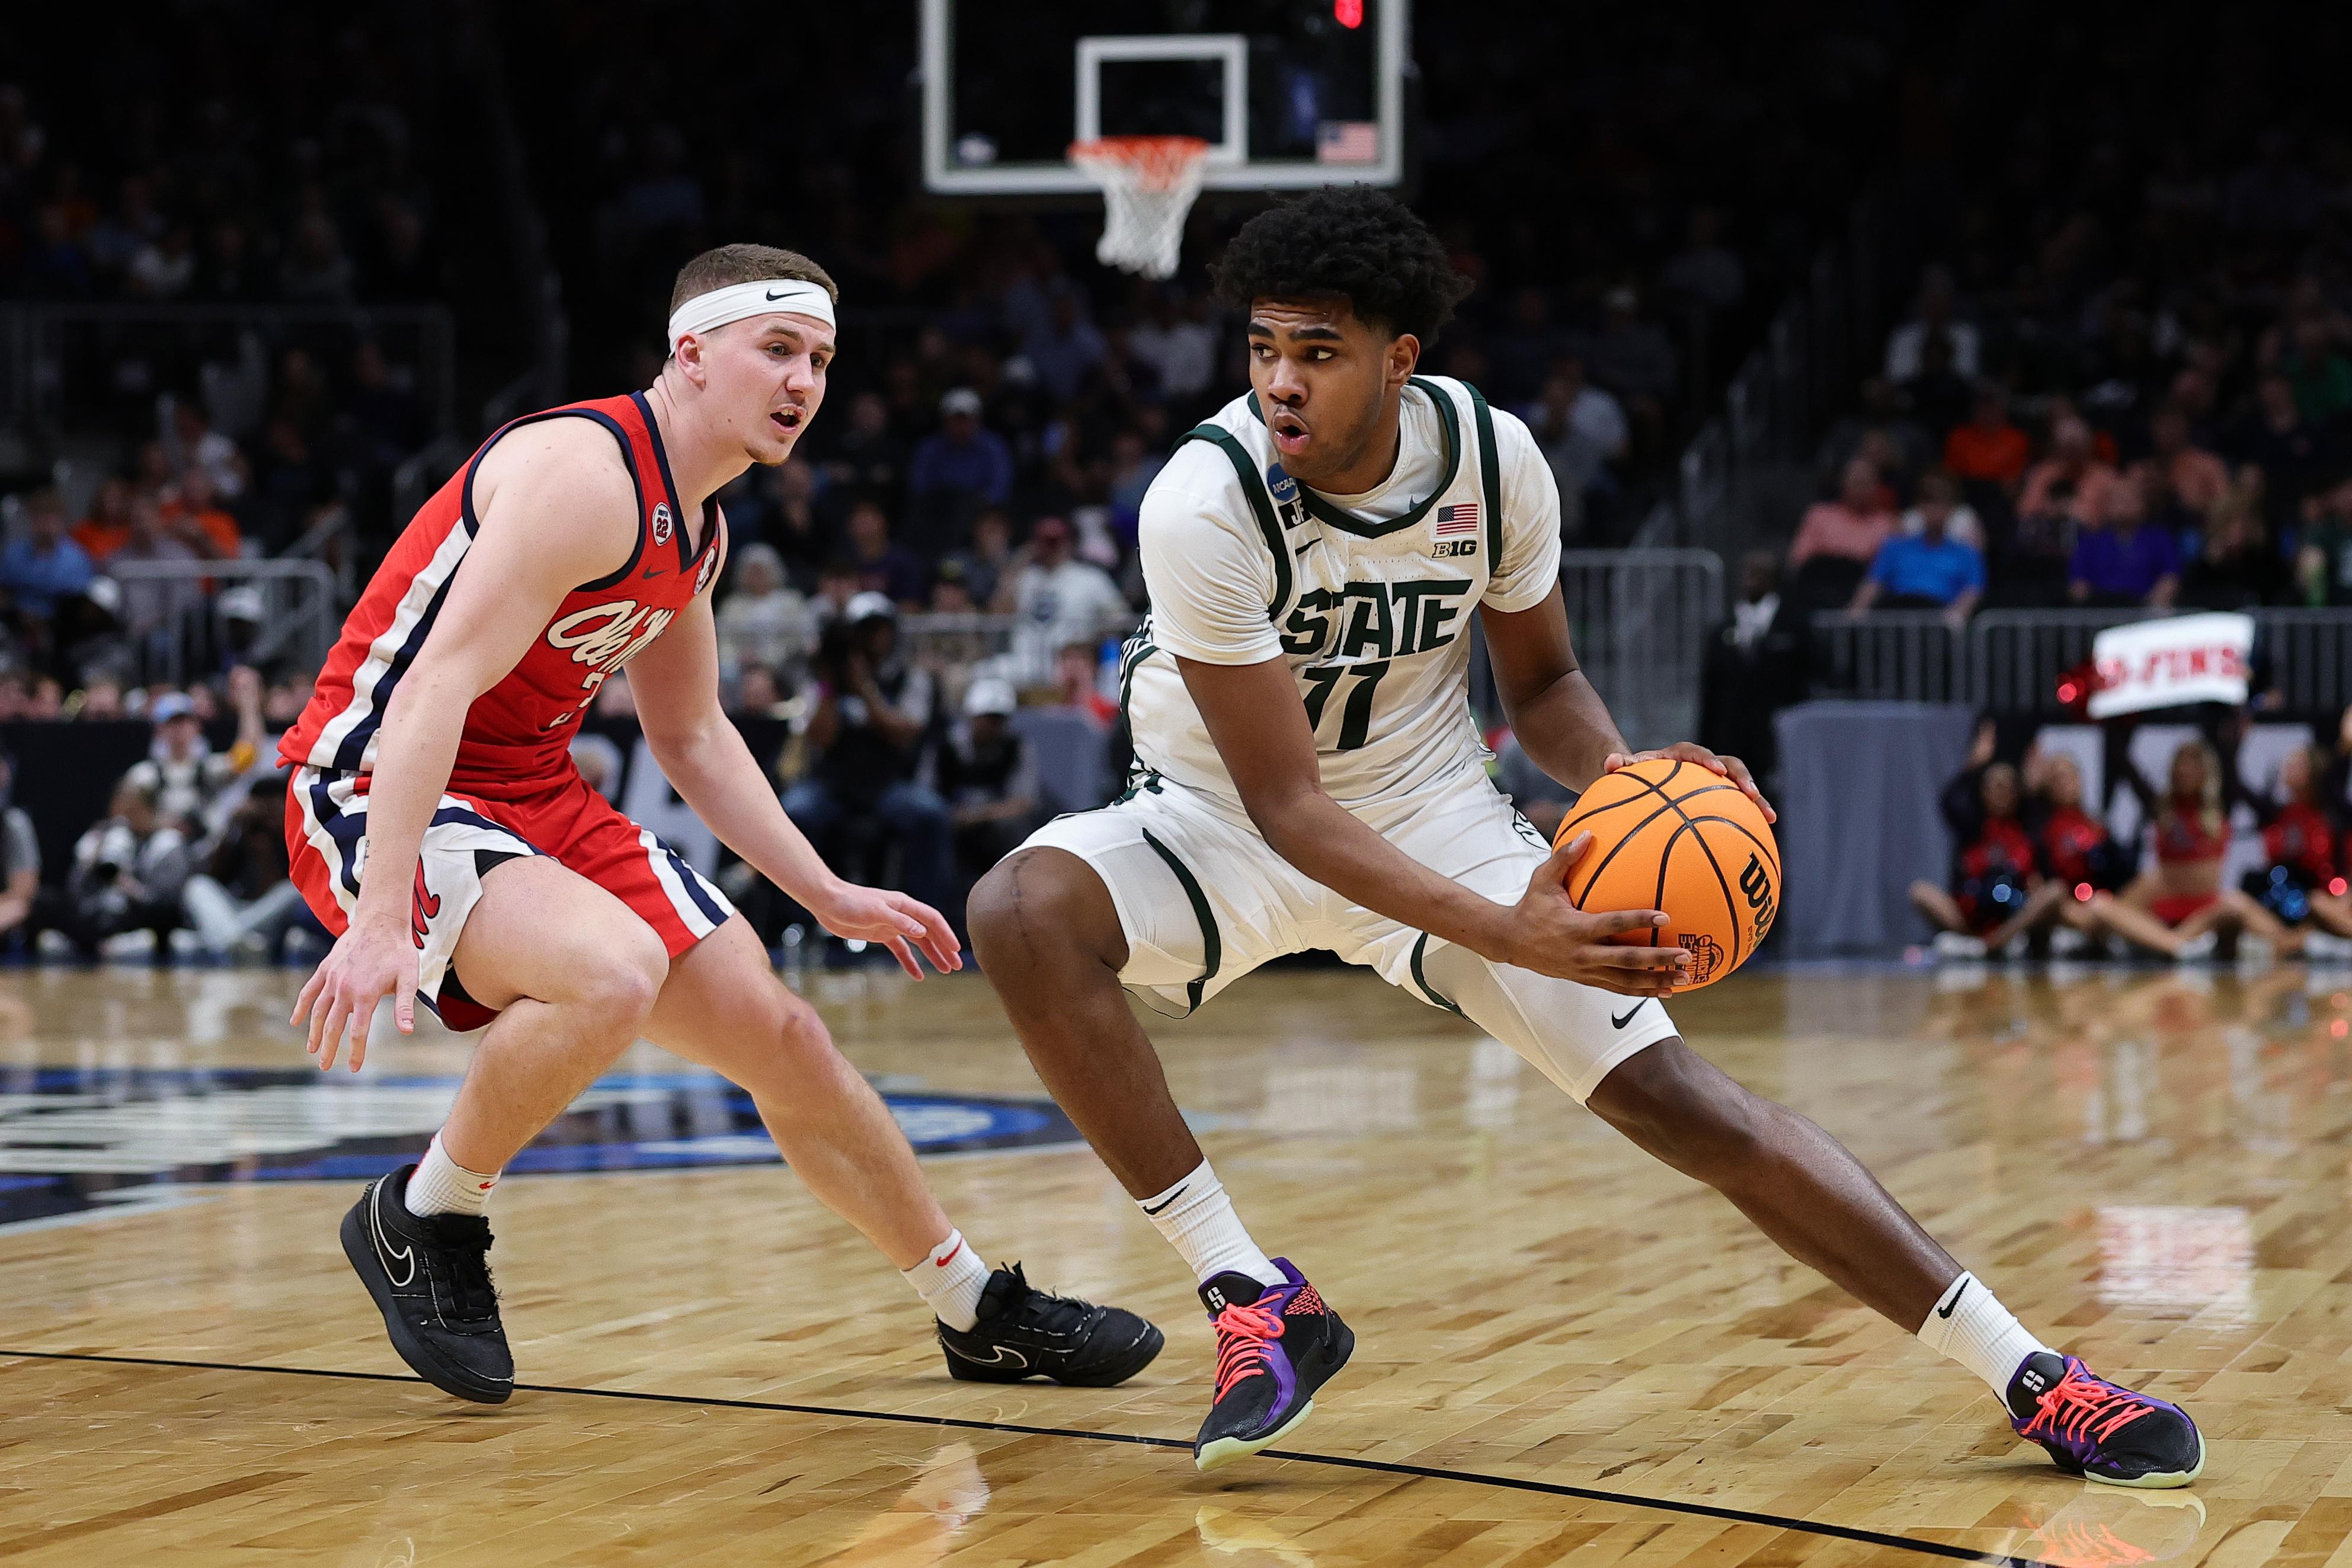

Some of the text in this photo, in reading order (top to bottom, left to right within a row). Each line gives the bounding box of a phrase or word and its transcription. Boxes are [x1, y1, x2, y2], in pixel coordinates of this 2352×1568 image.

[1272, 477, 1296, 494] NCAA
[656, 517, 669, 539] 22
[1279, 579, 1473, 658] STATE
[1697, 946, 1710, 975] MARCH
